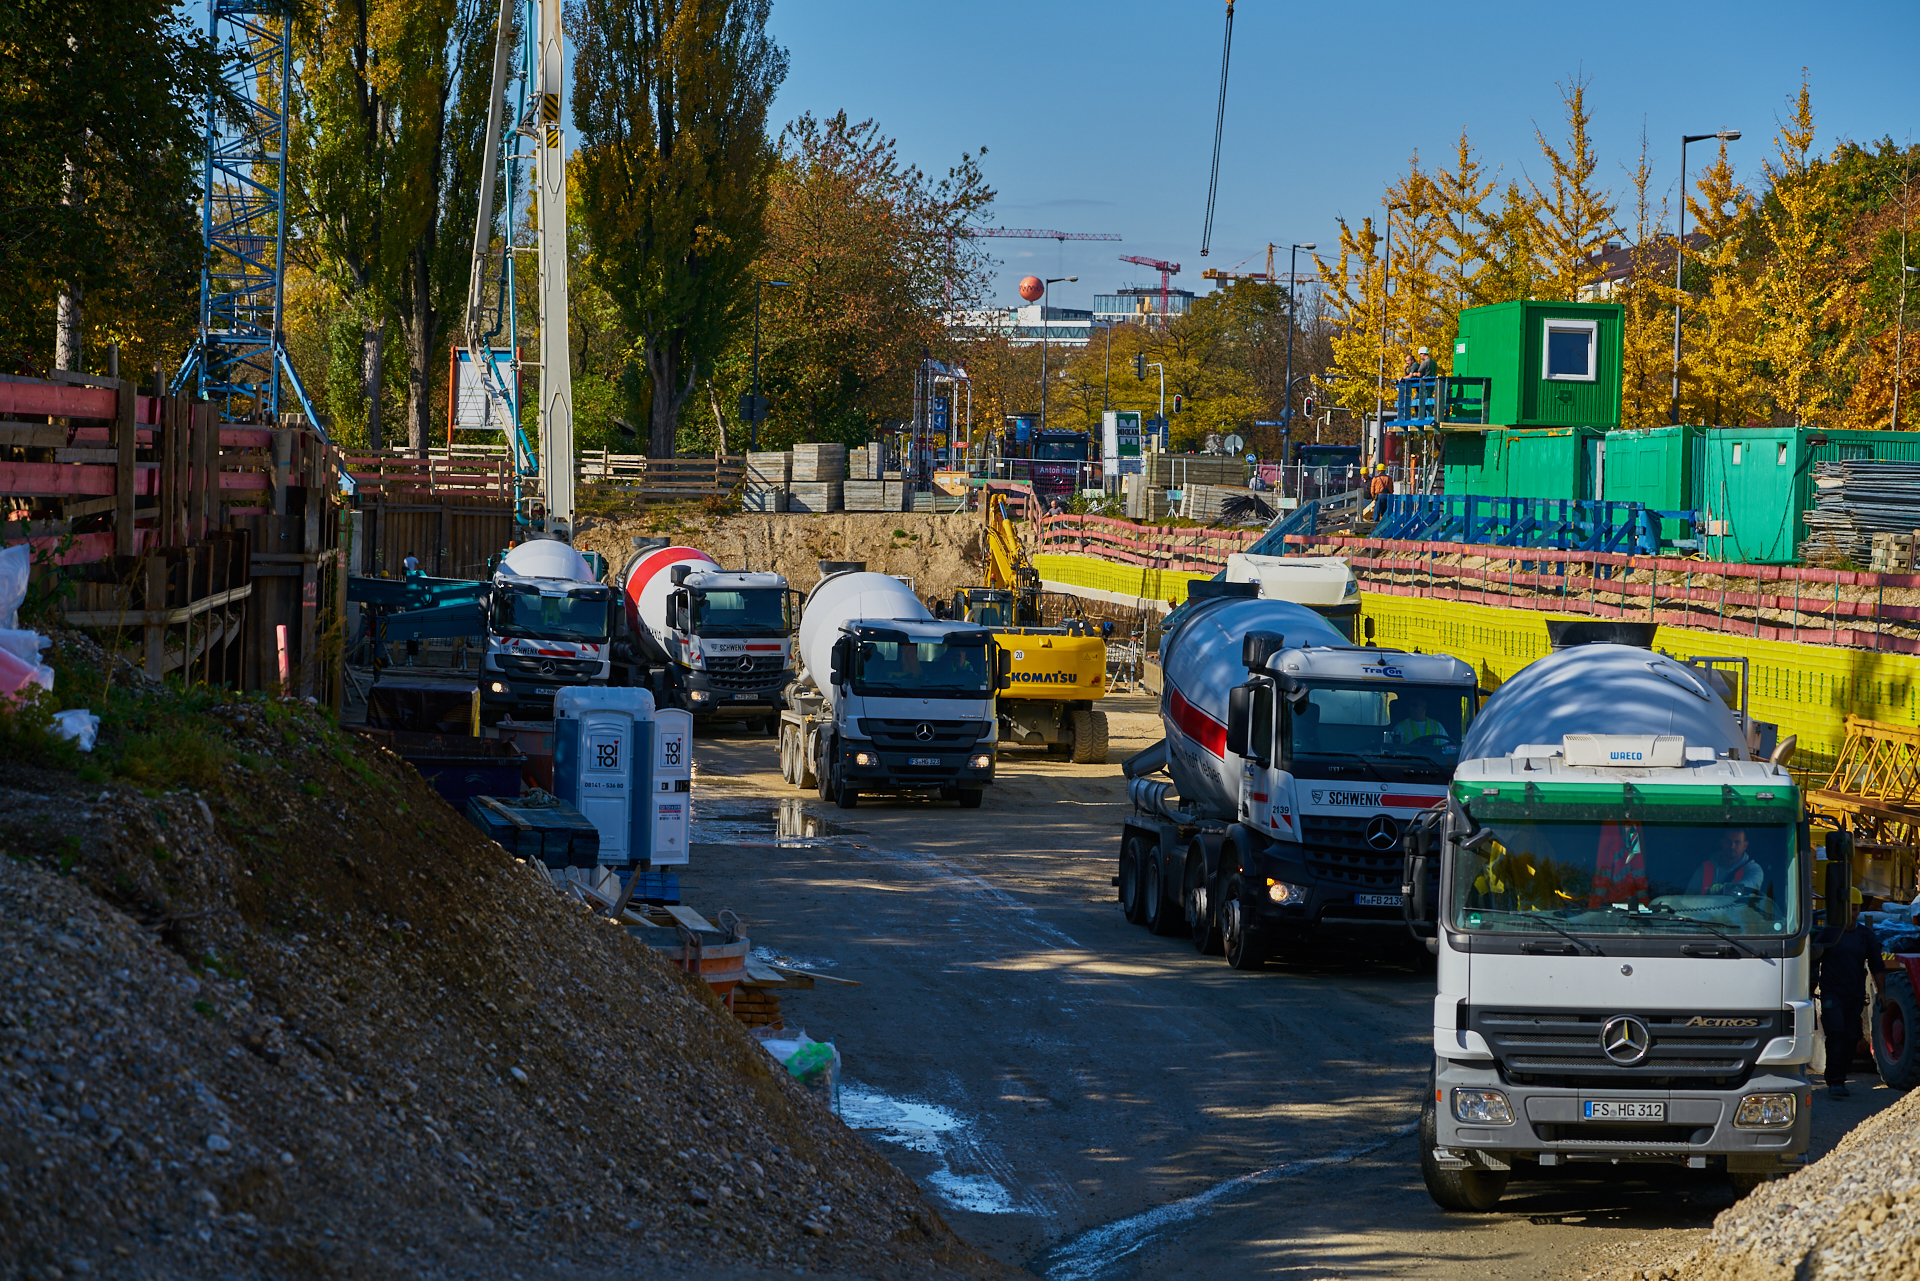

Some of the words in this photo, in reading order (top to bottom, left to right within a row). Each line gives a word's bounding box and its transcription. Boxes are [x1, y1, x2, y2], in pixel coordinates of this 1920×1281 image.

[1040, 466, 1060, 474] Anton
[511, 646, 538, 655] SCHWENK
[719, 644, 746, 652] SCHWENK
[1015, 651, 1023, 659] 20
[1011, 670, 1077, 683] KOMATSU
[1362, 666, 1404, 678] TraCon
[597, 743, 618, 756] TOI
[665, 741, 681, 754] TOI
[665, 753, 681, 765] TOI
[1610, 751, 1642, 760] WAECO
[596, 756, 618, 767] TOI
[1199, 755, 1225, 787] leben
[1329, 791, 1382, 806] SCHWENK
[1272, 805, 1289, 814] 2139
[1371, 896, 1382, 905] FB
[1592, 1103, 1609, 1117] FS
[1618, 1104, 1635, 1116] HG
[1638, 1104, 1662, 1117] 312
